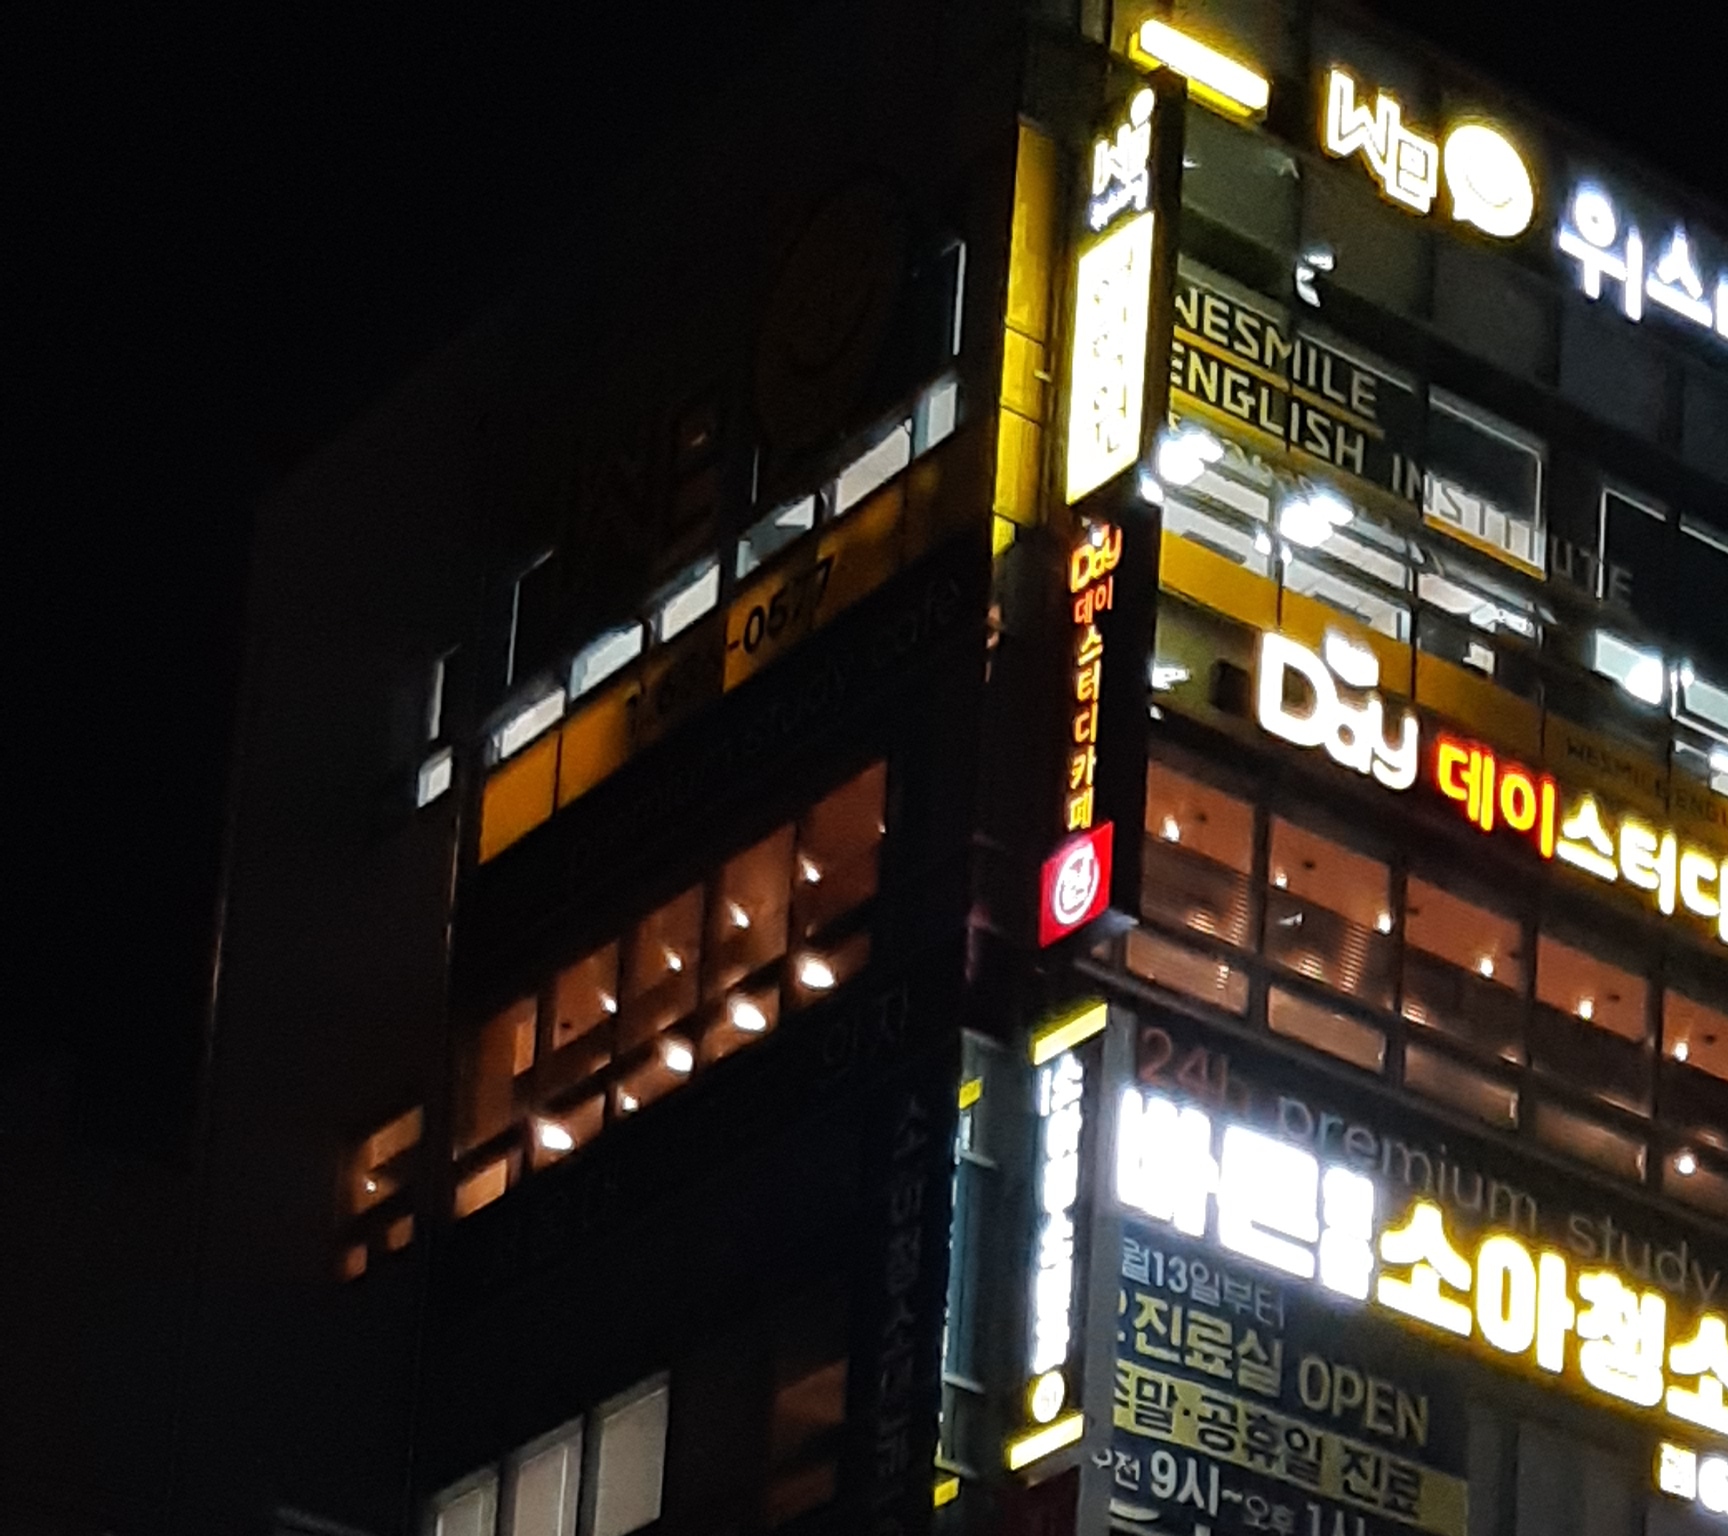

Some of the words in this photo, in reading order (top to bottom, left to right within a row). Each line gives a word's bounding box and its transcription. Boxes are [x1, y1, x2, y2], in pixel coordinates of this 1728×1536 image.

[1168, 342, 1366, 475] ENGLISH
[1277, 1091, 1538, 1233] premium
[1566, 1208, 1723, 1303] study
[1299, 1357, 1428, 1445] OPEN
[1341, 1444, 1423, 1519] 진료
